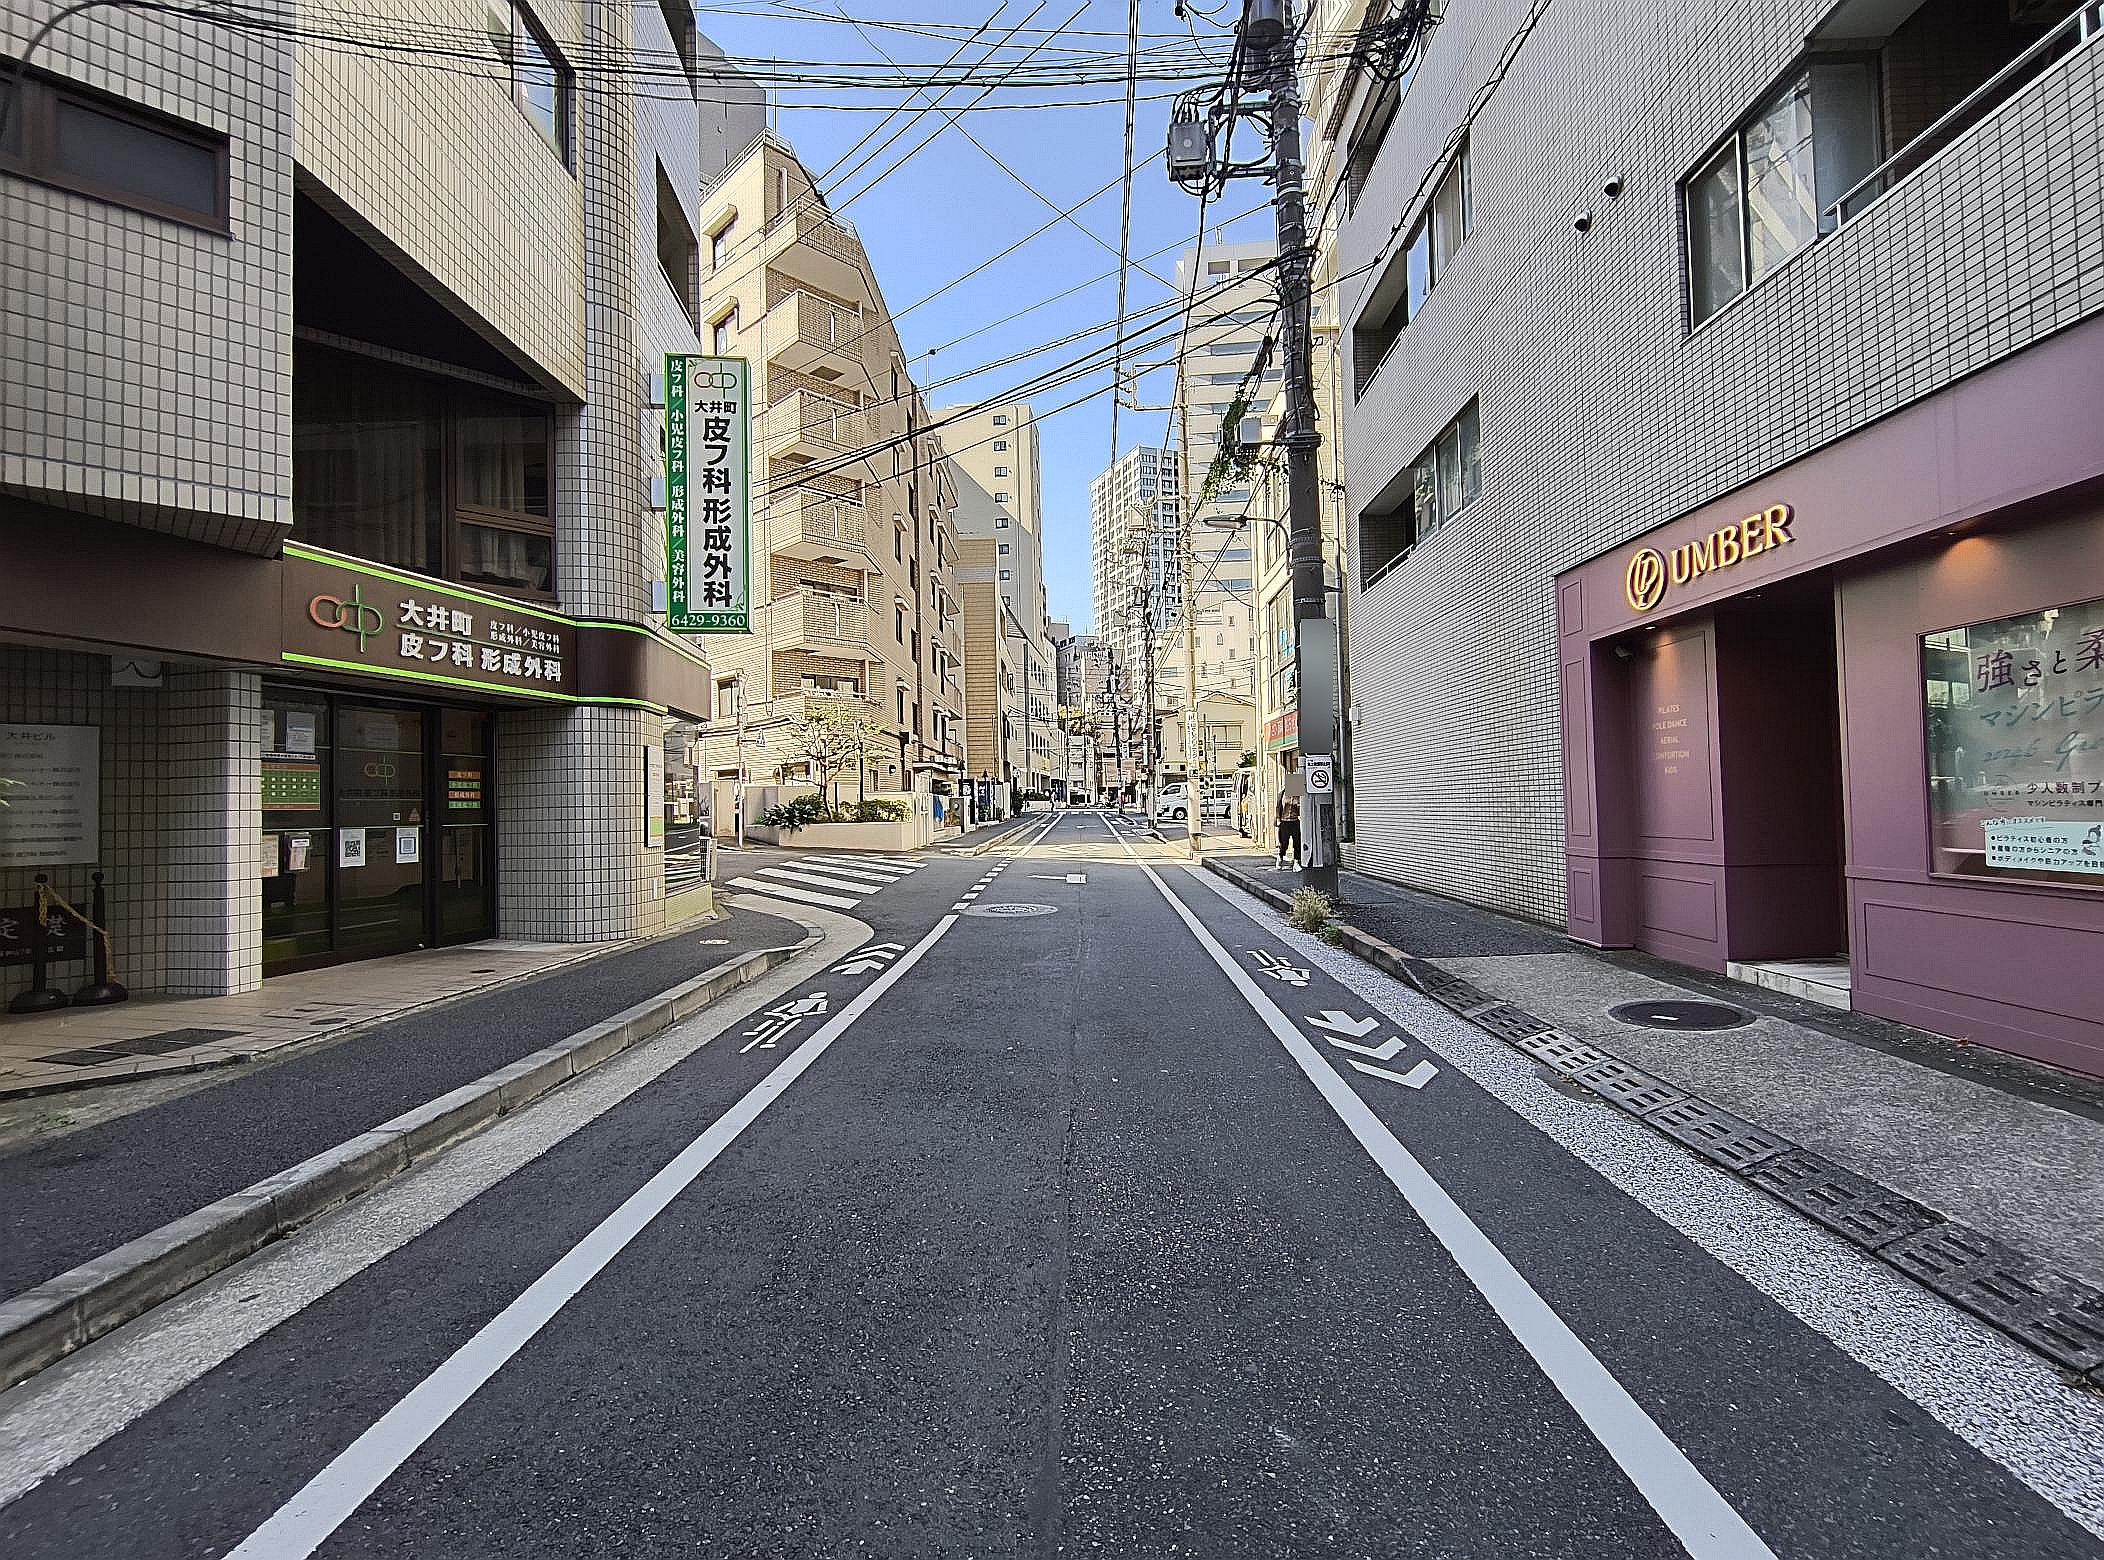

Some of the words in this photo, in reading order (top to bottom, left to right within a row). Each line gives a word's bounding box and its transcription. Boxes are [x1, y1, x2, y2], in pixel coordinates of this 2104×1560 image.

[694, 400, 736, 414] 大井町
[1671, 503, 1794, 584] UMBER
[400, 599, 473, 636] 大井町
[671, 614, 745, 627] 6429-9360
